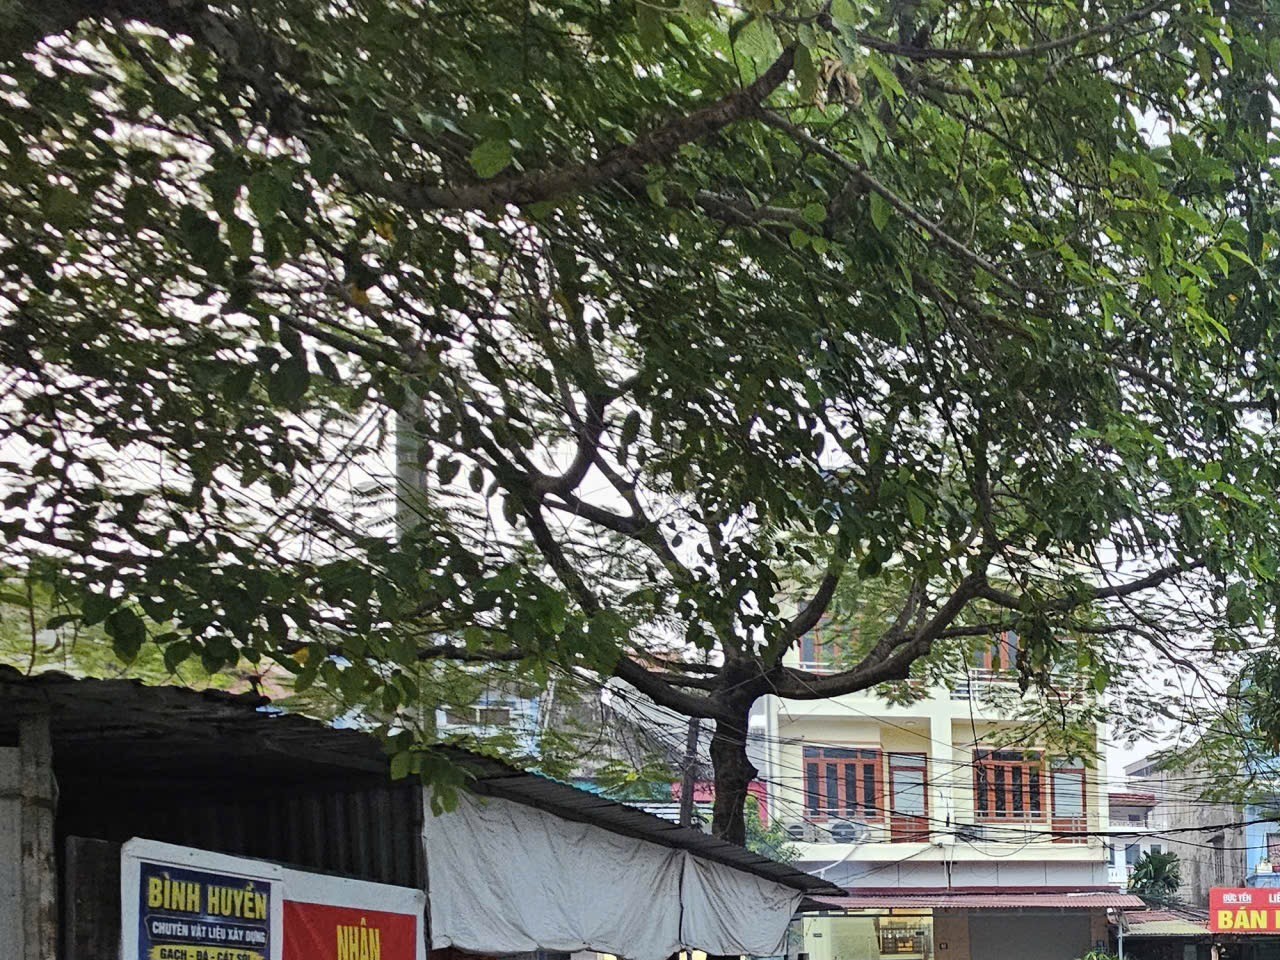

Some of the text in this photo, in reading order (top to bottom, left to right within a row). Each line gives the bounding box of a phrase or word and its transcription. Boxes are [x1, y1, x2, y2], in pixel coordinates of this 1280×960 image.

[148, 871, 200, 913] BÌNH
[1218, 906, 1268, 929] BÁN
[152, 921, 189, 937] CHUYÊN
[191, 925, 206, 940] VẬT
[208, 925, 226, 941] LIỆU
[227, 927, 244, 940] XÂY
